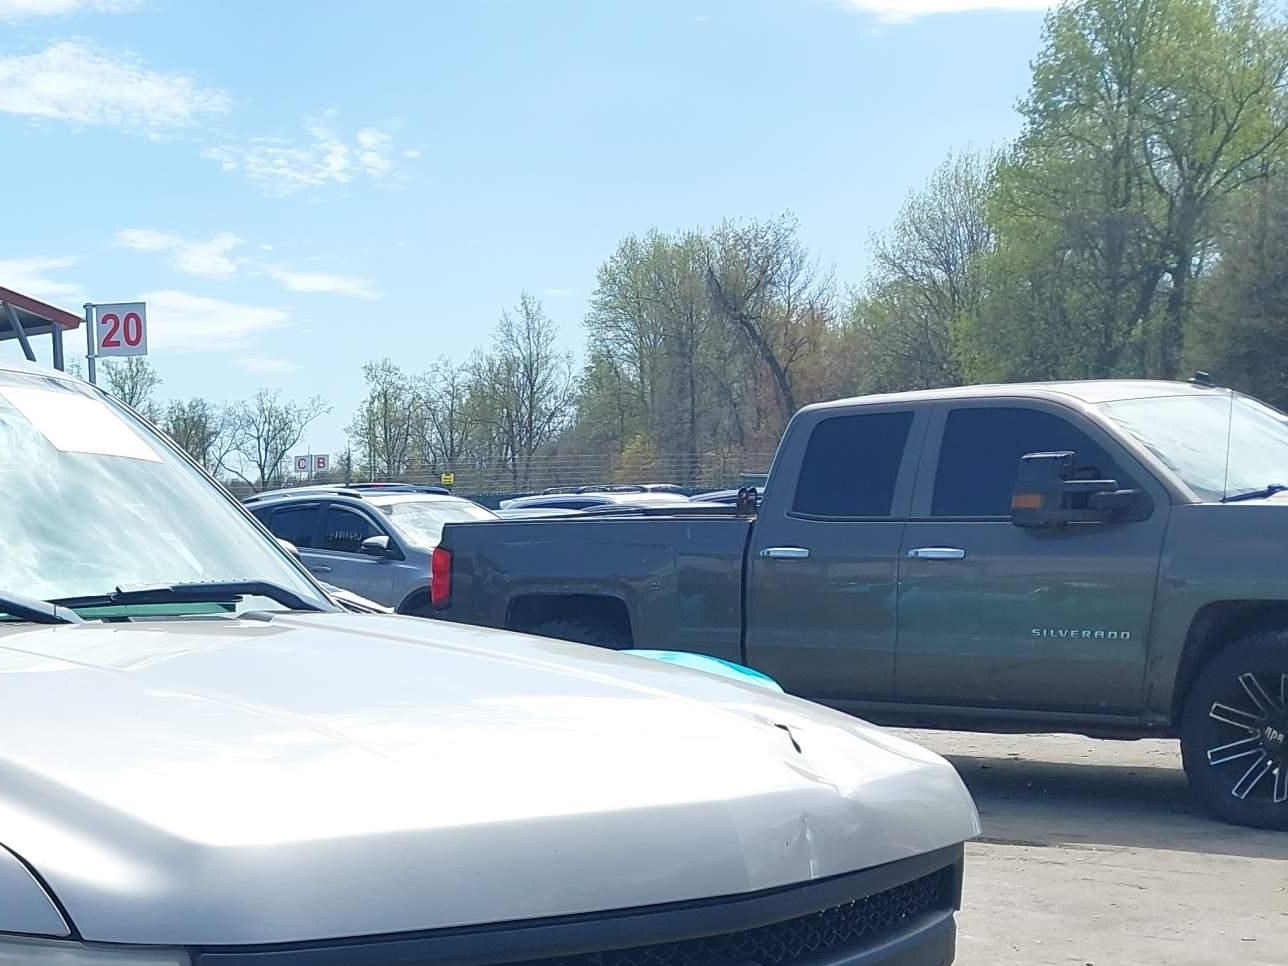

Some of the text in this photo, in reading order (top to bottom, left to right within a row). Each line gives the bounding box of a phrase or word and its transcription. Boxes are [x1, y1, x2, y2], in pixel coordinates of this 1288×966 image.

[100, 311, 143, 348] 20
[297, 457, 307, 470] C
[317, 457, 326, 469] B
[1031, 628, 1131, 640] SILVERADO
